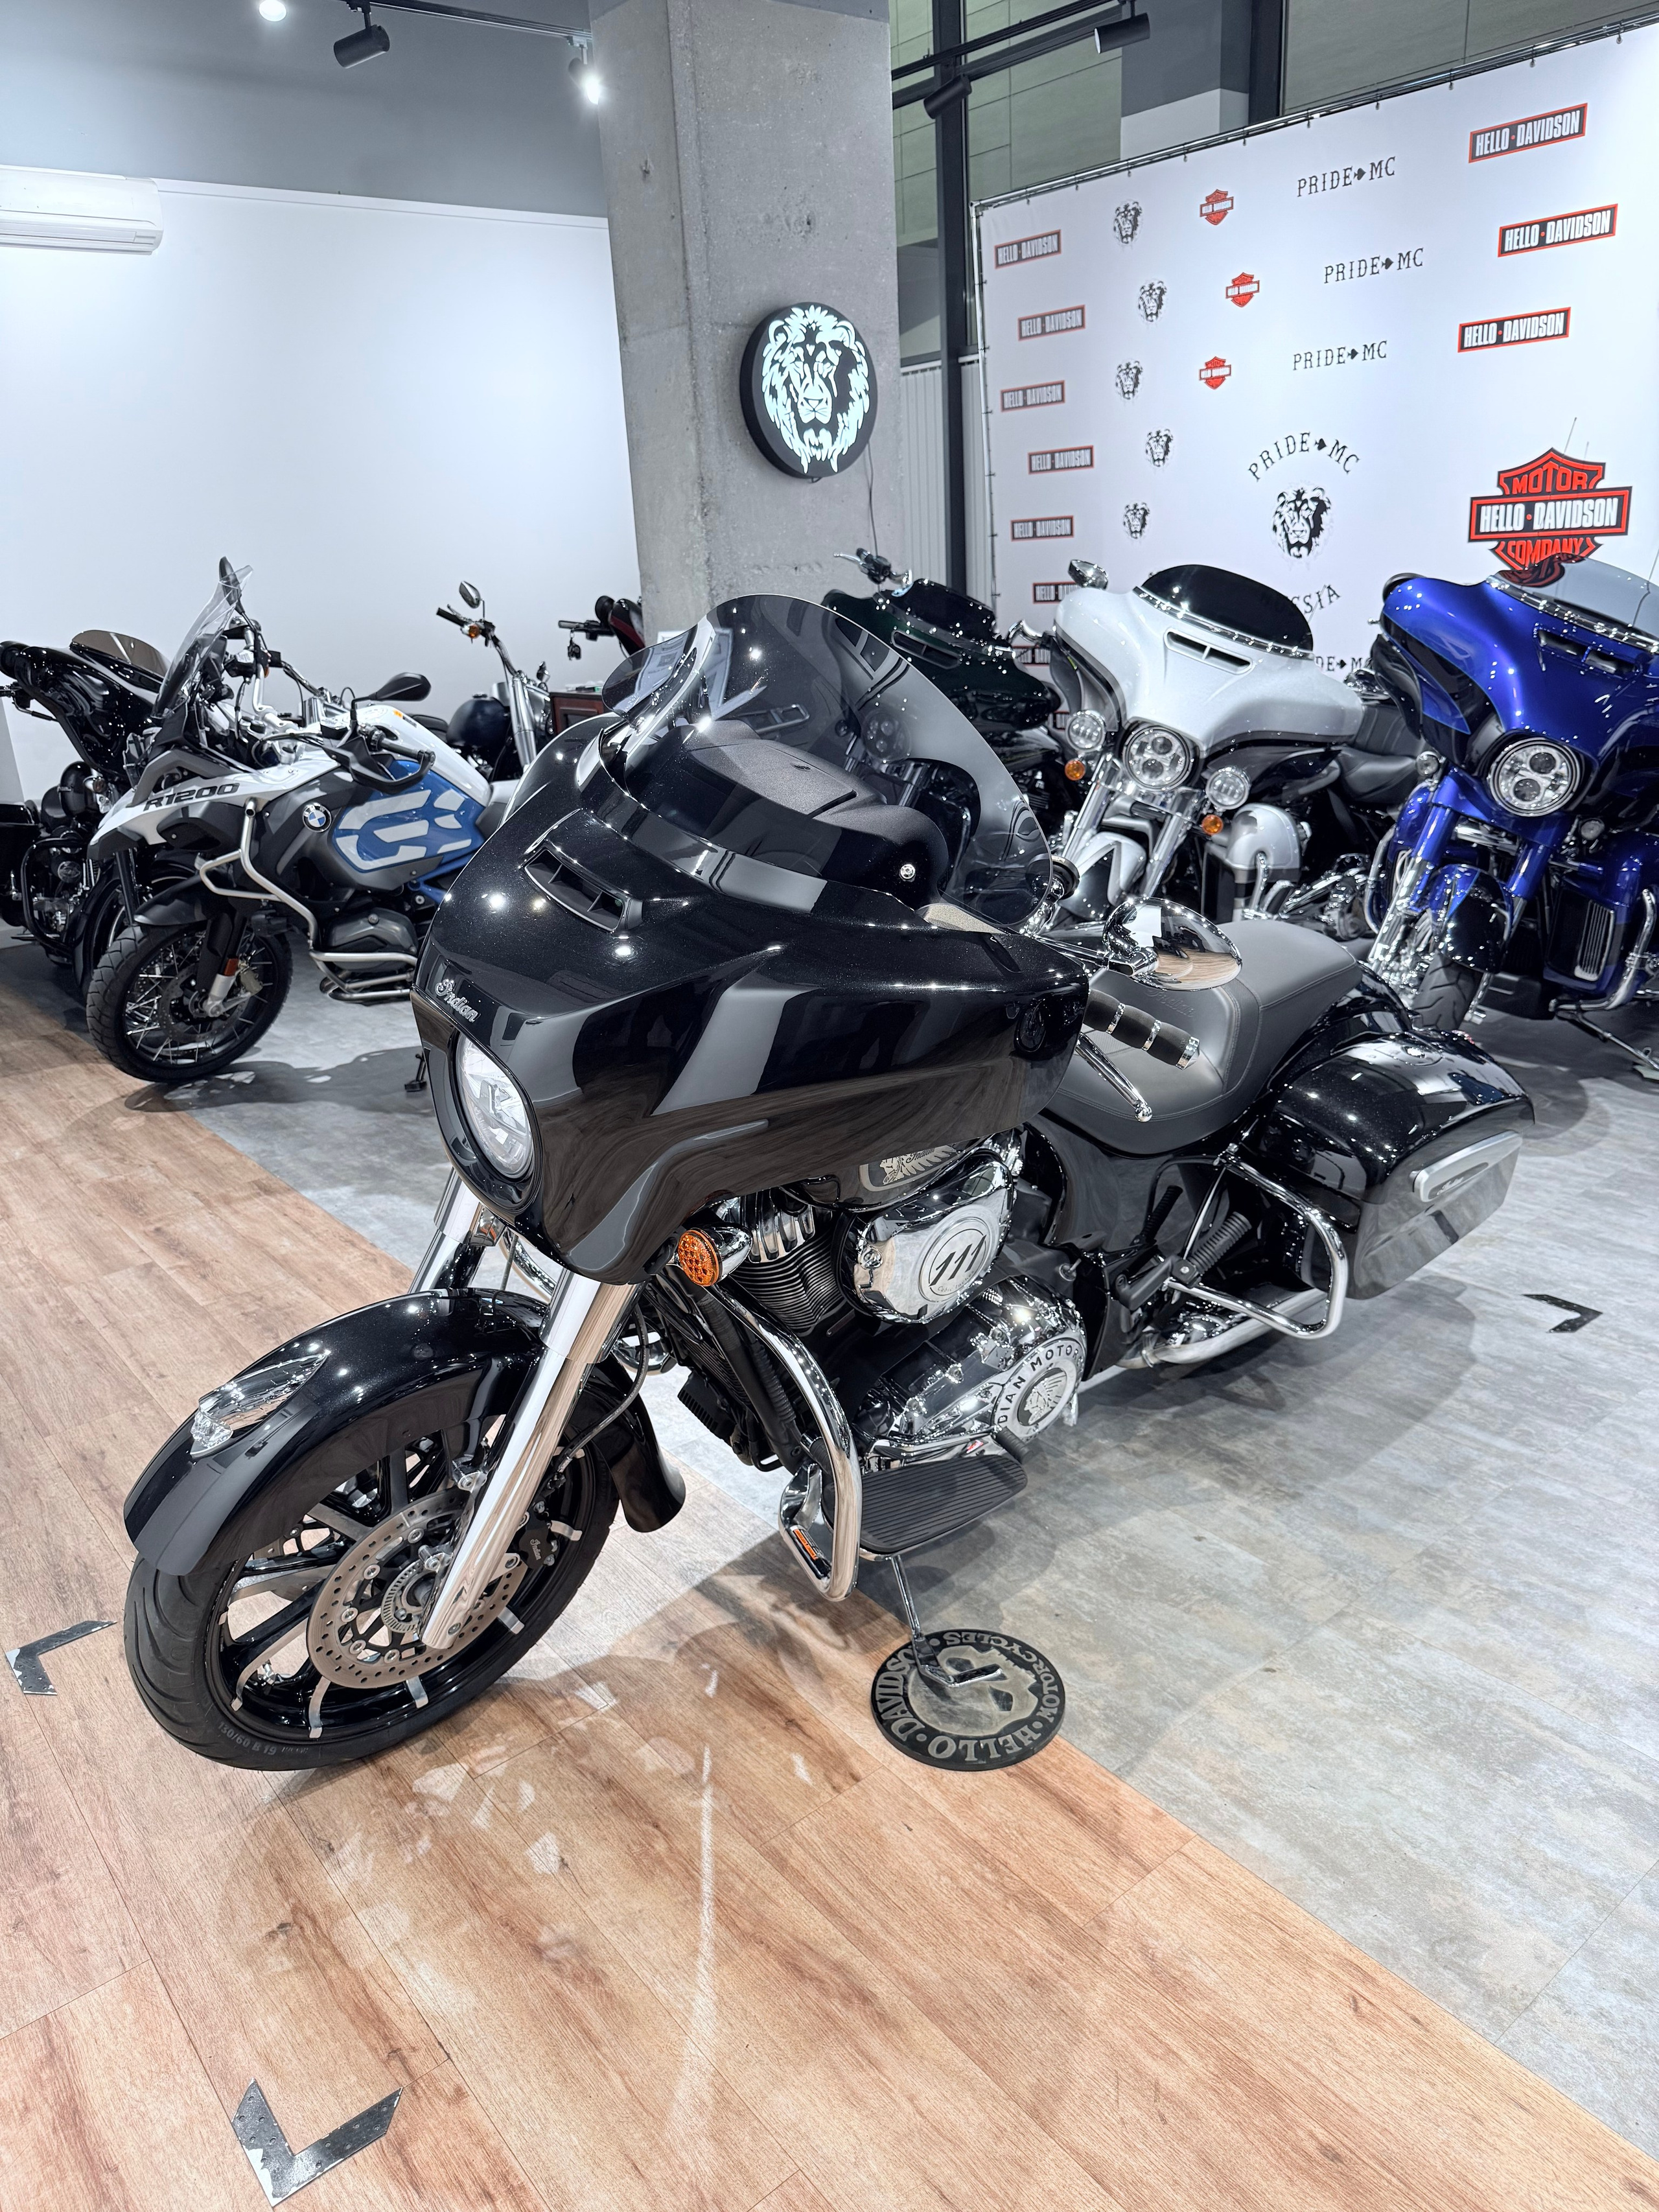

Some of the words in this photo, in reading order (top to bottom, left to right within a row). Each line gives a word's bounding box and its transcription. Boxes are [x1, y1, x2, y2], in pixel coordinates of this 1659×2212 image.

[1475, 128, 1509, 156] HELLO
[1516, 110, 1581, 146] DAVIDSON
[1297, 166, 1353, 197] PRIDE
[1368, 156, 1397, 181] MC
[1504, 224, 1540, 252] HELLO
[1546, 209, 1611, 244] DAVIDSON
[1324, 255, 1380, 283] PRIDE
[1396, 248, 1424, 270] MC
[1464, 323, 1498, 348] HELLO
[1502, 312, 1565, 342] DAVIDSON
[1293, 346, 1346, 371] PRIDE
[1362, 340, 1387, 361] MC
[1248, 432, 1310, 482] PRIDE
[1327, 439, 1361, 474] MC
[1512, 461, 1587, 495] MOTOR
[1479, 503, 1525, 533] HELLO
[1533, 498, 1618, 530] DAVIDSON
[143, 783, 240, 812] R1200
[434, 978, 481, 1023] Indian
[929, 1235, 987, 1287] 111
[997, 1375, 1027, 1425] DIAN
[876, 1646, 925, 1742] DAVIDSO
[942, 1631, 1060, 1723] MOTORCYCLES
[217, 1721, 251, 1748] 130/60
[251, 1742, 261, 1752] B
[263, 1745, 277, 1756] 19
[927, 1727, 1043, 1762] HELLO
